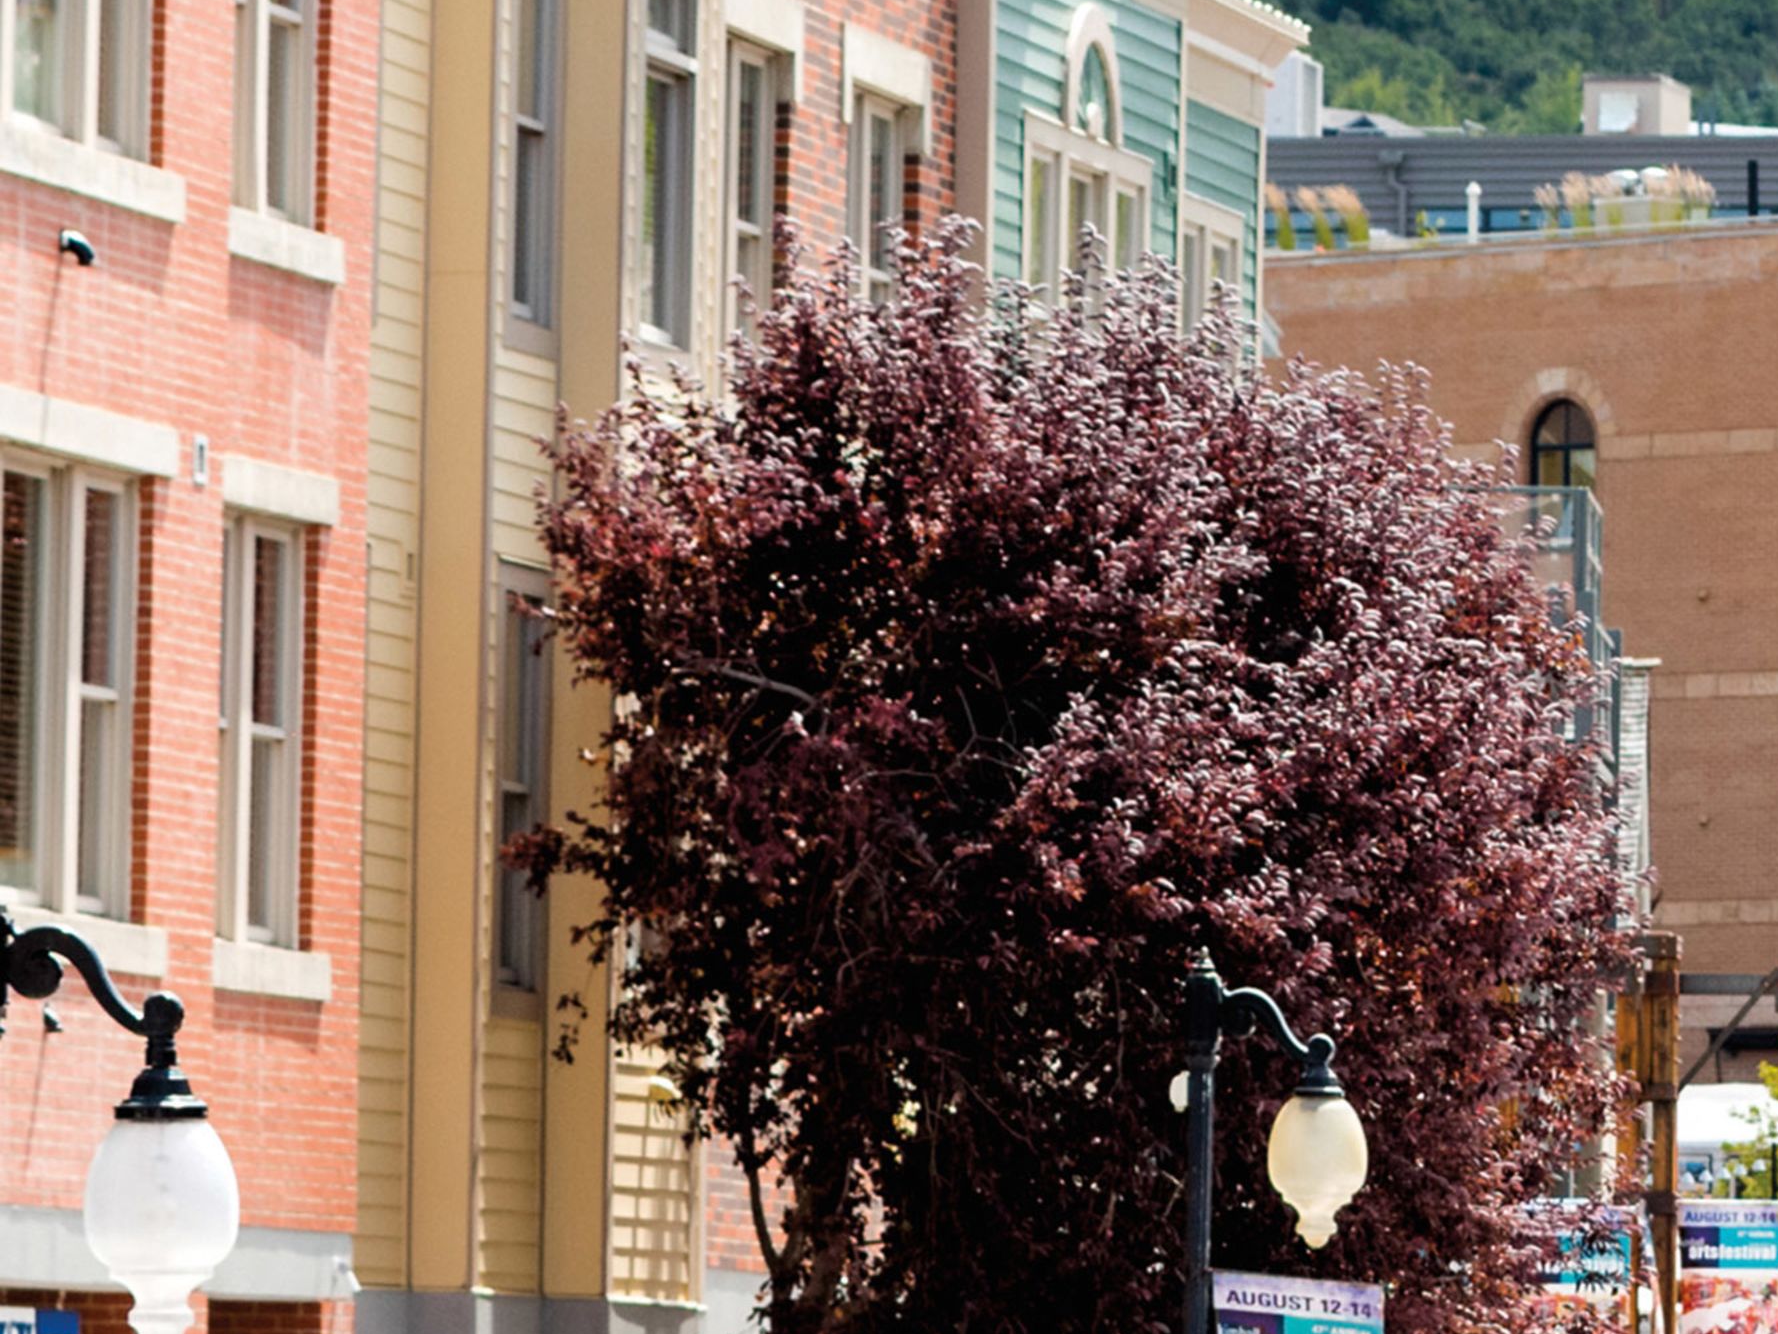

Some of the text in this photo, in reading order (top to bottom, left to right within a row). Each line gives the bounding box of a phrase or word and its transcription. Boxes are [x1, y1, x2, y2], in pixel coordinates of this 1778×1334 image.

[1685, 1211, 1776, 1223] AUGUST 12-14
[1226, 1290, 1373, 1318] AUGUST 12-14
